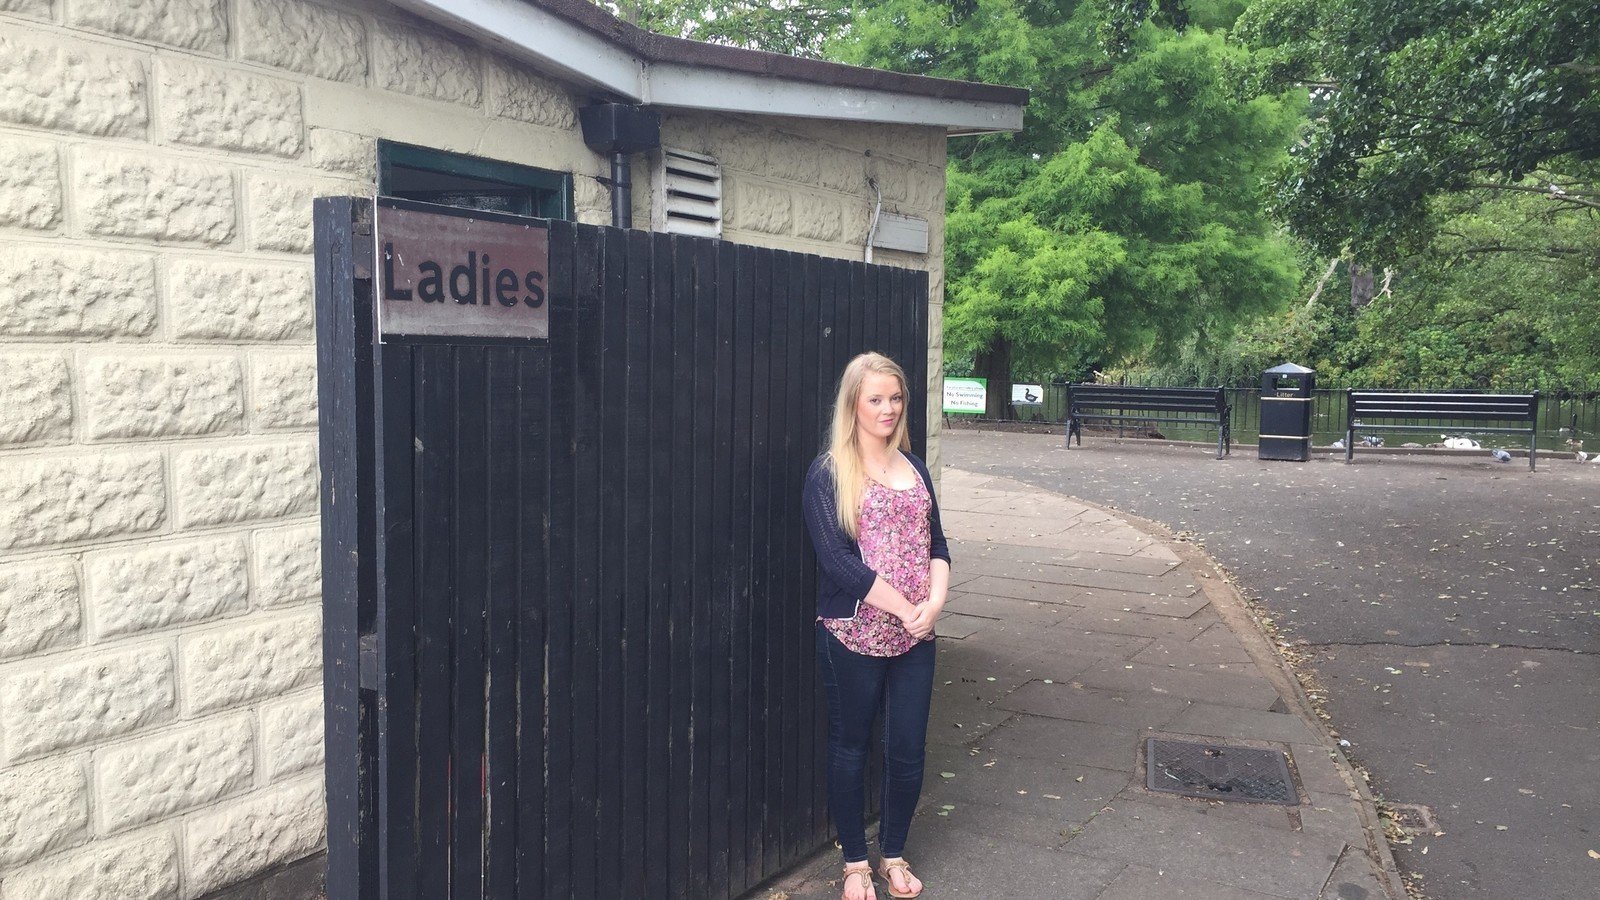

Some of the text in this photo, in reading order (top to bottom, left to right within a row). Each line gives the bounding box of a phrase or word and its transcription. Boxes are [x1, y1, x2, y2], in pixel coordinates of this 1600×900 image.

[384, 242, 545, 308] Ladies
[956, 391, 984, 400] Swimming
[960, 400, 979, 408] Fishing
